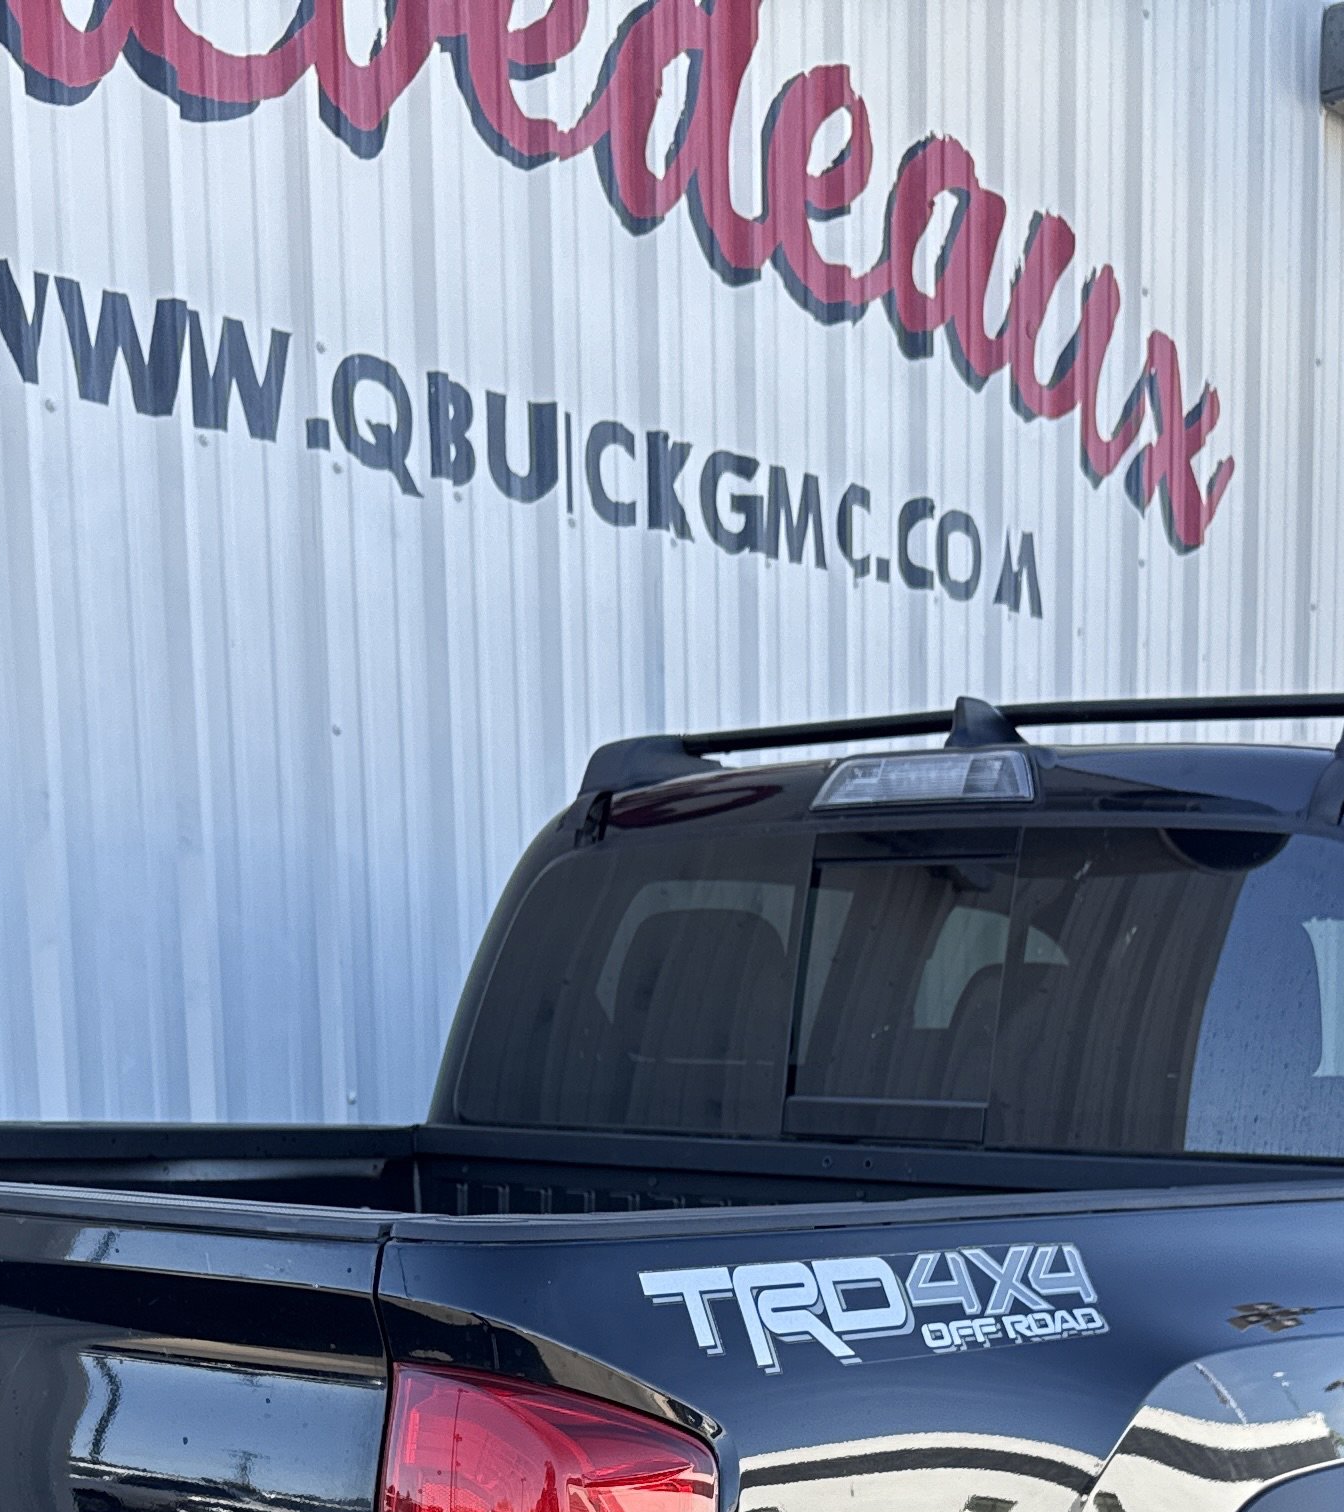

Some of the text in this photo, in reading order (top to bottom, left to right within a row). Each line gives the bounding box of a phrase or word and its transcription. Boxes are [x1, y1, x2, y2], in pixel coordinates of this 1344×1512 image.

[638, 1254, 916, 1375] TRD
[920, 1306, 1111, 1354] OFF ROAD
